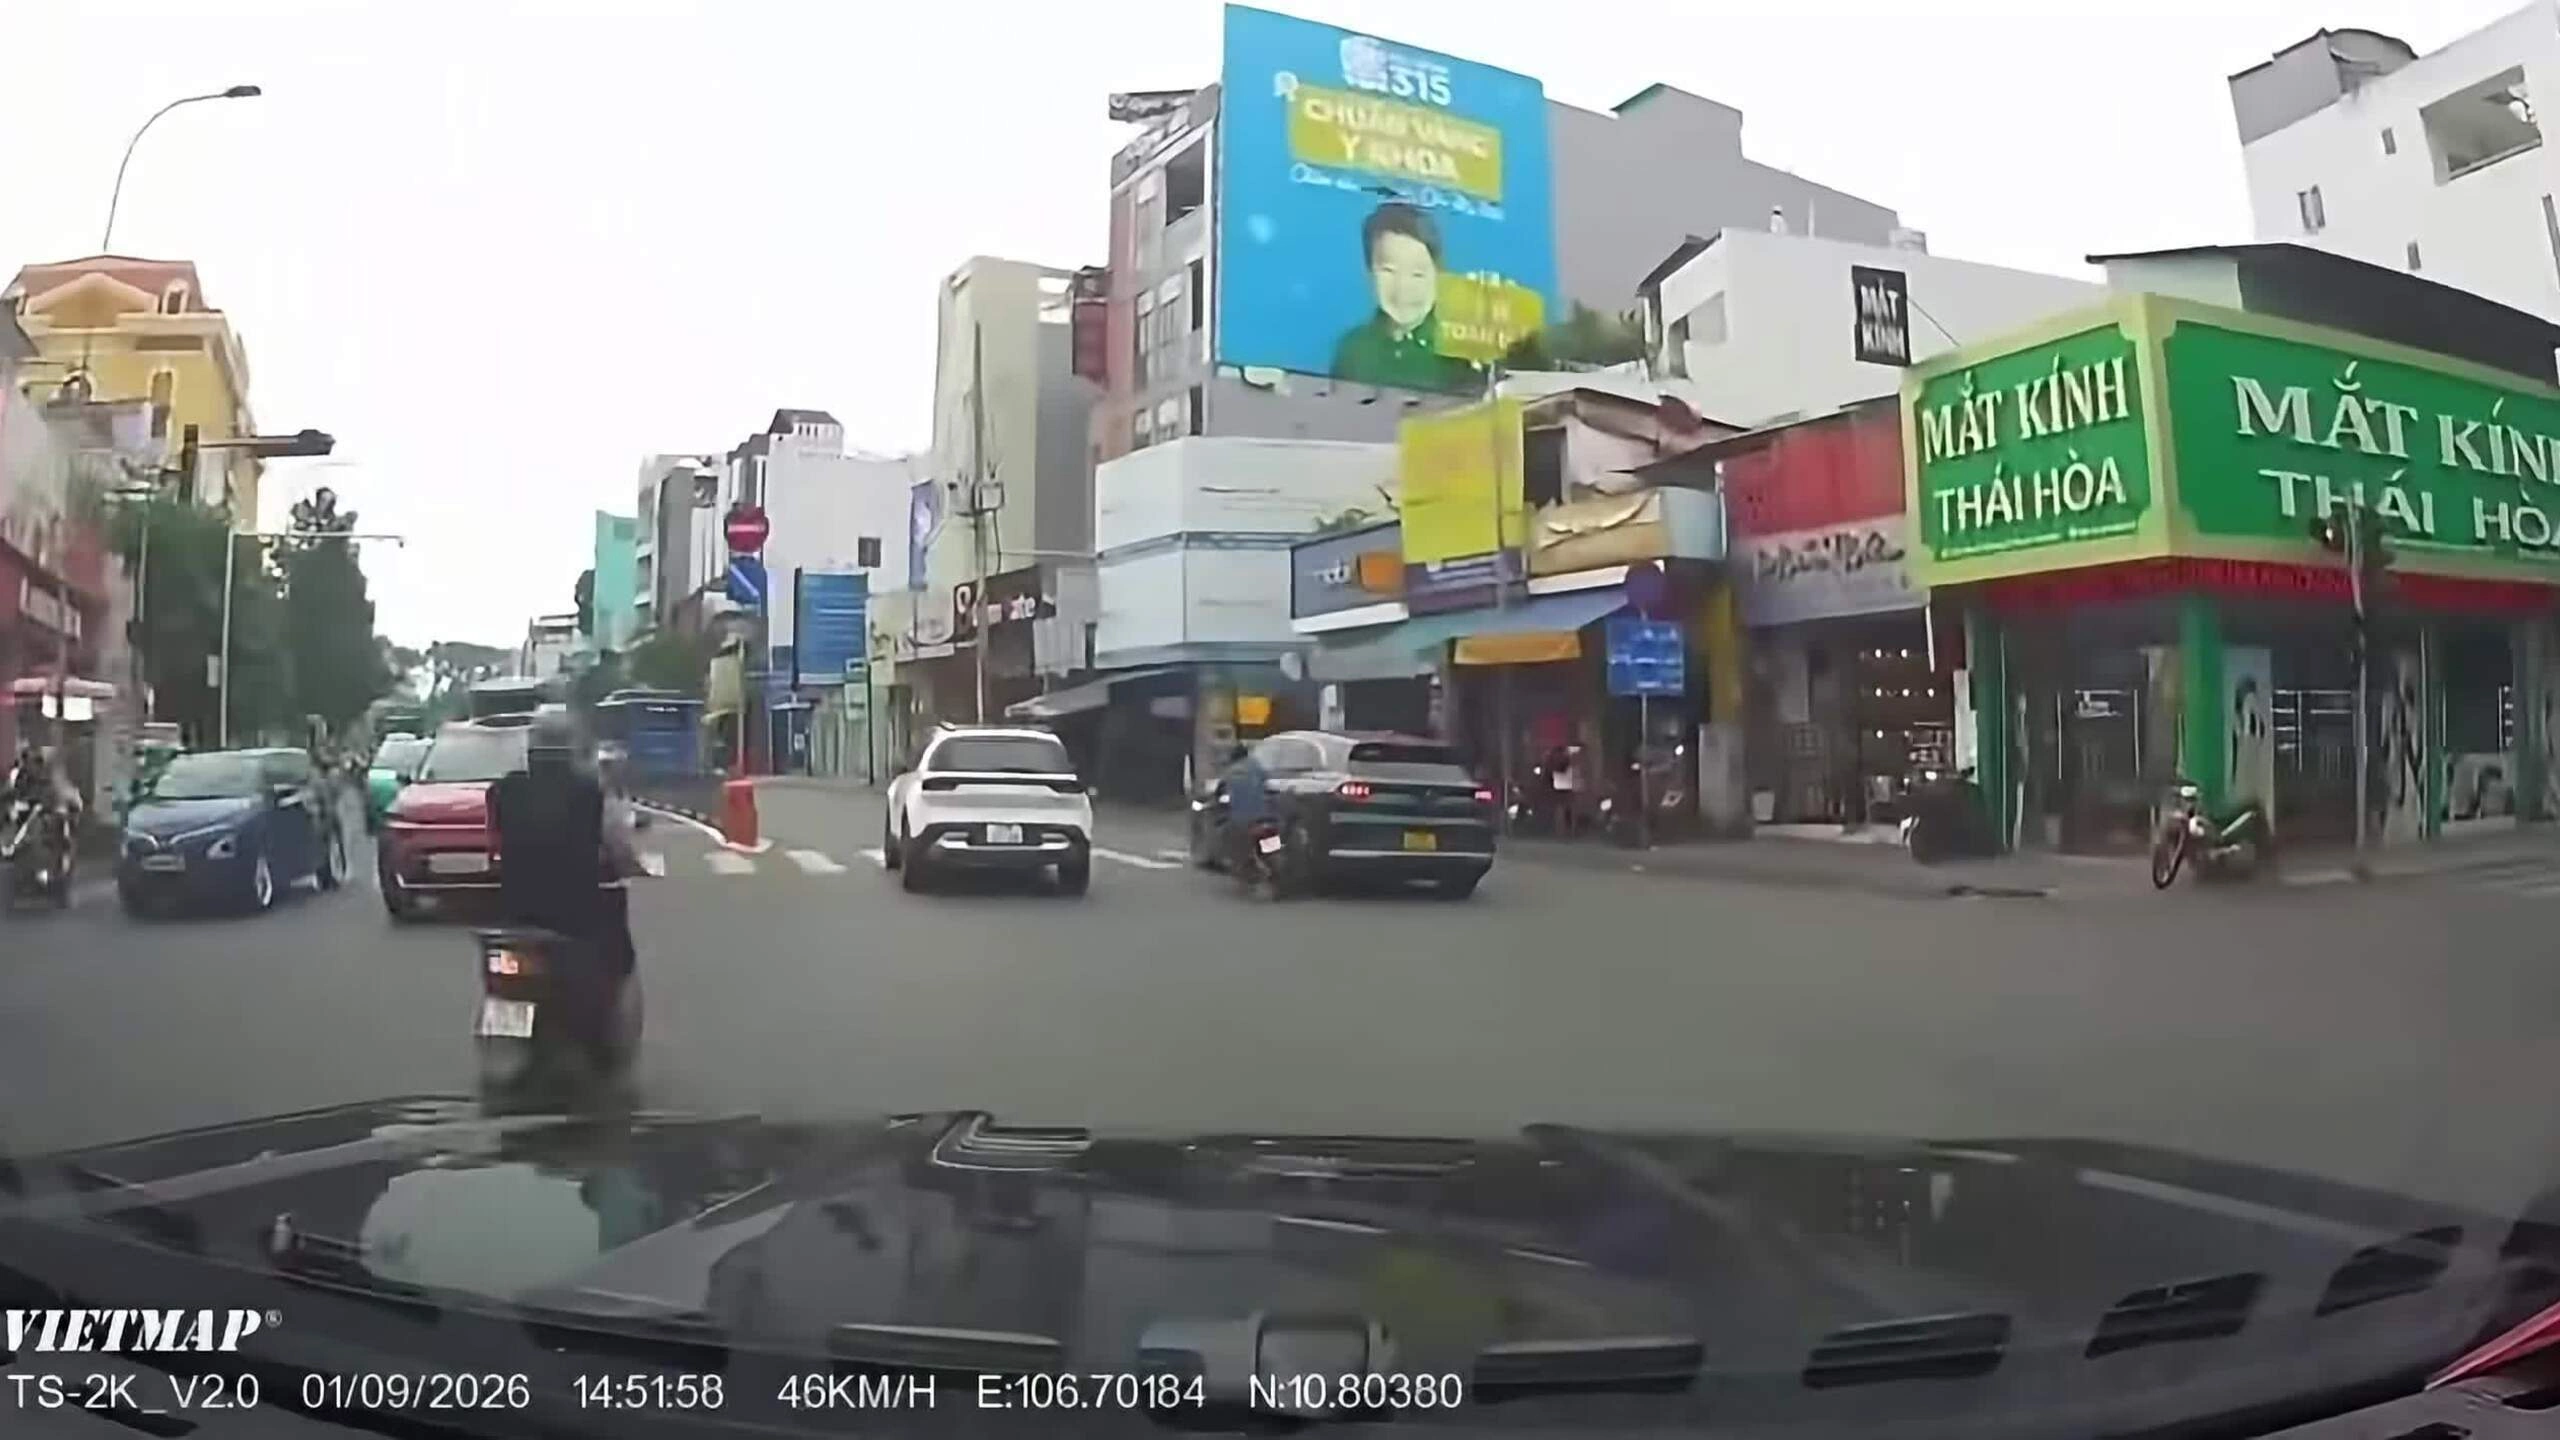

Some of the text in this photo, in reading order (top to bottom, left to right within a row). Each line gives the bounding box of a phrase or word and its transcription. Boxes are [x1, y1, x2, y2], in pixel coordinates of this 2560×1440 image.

[1389, 65, 1452, 106] 315
[1336, 129, 1362, 162] Y
[1921, 352, 2130, 465] MẮT KÍNH
[2229, 360, 2419, 459] MẮT
[1932, 447, 2127, 535] THÁI HÒA
[2257, 467, 2560, 546] THÁI HÒ
